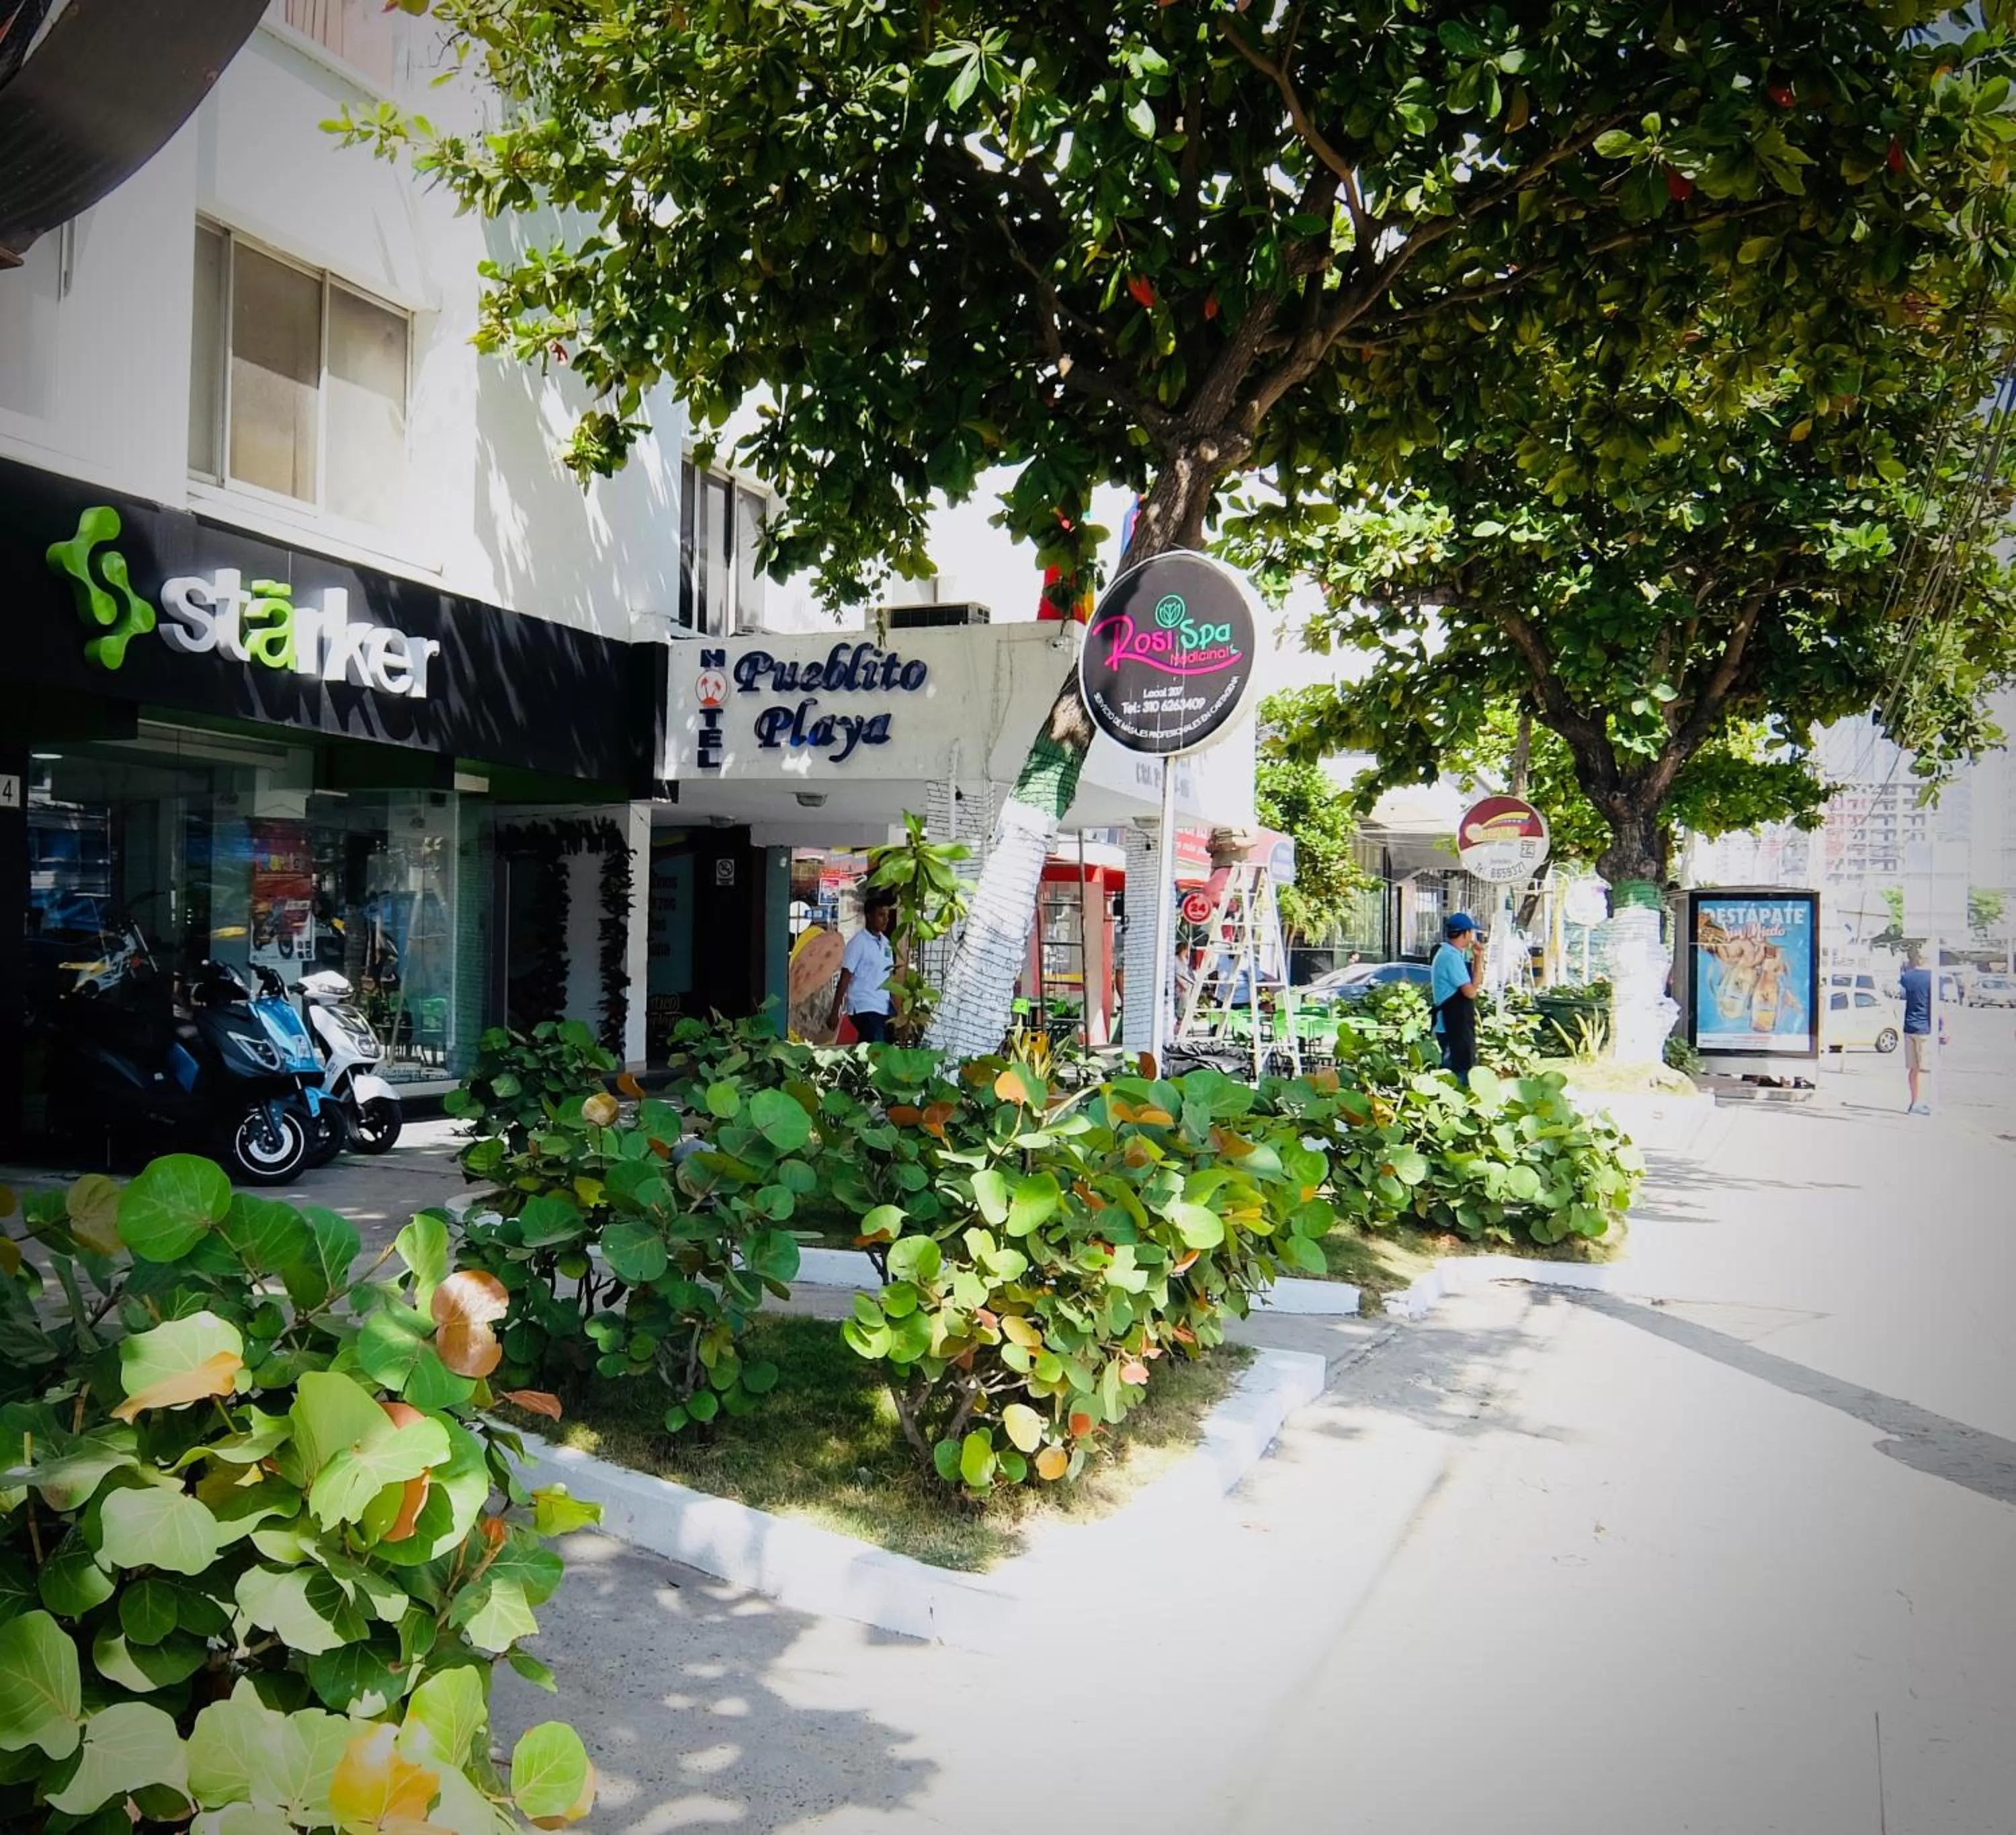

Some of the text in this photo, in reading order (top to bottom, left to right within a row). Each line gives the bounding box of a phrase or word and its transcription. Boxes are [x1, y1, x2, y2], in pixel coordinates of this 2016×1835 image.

[159, 568, 440, 698] stärker
[1092, 615, 1231, 672] Rosi Spa
[733, 642, 928, 692] Pueblito
[1170, 645, 1229, 667] Medicinal
[1143, 688, 1167, 698] Local
[754, 698, 892, 762] Playa
[3, 779, 13, 803] 4
[1191, 903, 1206, 913] 24
